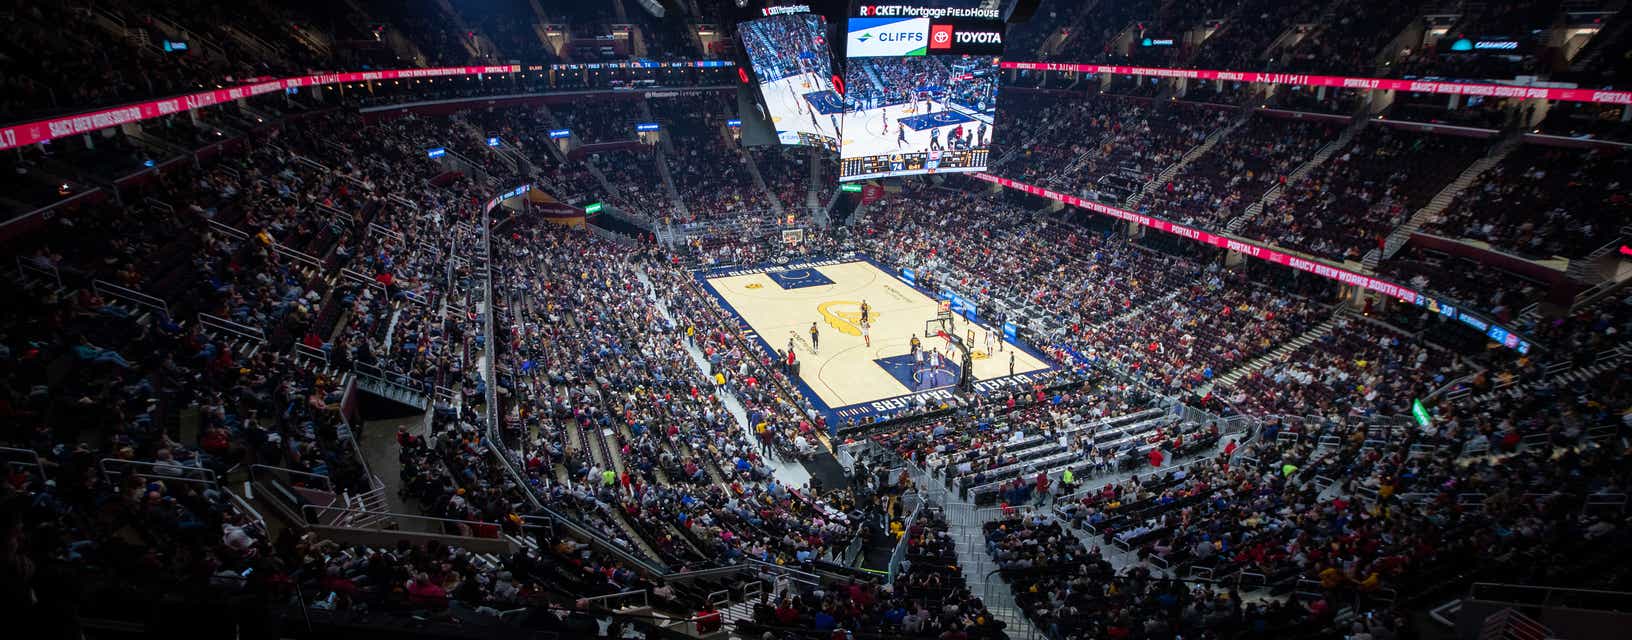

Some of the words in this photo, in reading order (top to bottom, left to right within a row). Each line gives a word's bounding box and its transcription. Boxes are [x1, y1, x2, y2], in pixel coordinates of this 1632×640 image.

[860, 5, 902, 16] ROCKET
[902, 6, 946, 19] Mortgage
[879, 32, 923, 42] CLIFFS
[955, 32, 1001, 44] TOYOTA
[1343, 79, 1369, 88] PORTAL
[1370, 80, 1380, 88] 17
[1409, 82, 1437, 93] SAUCY
[1437, 83, 1462, 94] BREW
[1462, 85, 1494, 96] WORKS
[1494, 86, 1526, 97] SOUTH
[1526, 88, 1548, 98] PUB
[1592, 91, 1632, 103] PORTAL
[892, 163, 903, 171] 74
[1080, 199, 1094, 209] SAUCY
[1139, 216, 1150, 225] PUB
[1171, 225, 1193, 238] PORTAL
[1192, 231, 1200, 239] 17
[1227, 240, 1252, 254] PORTAL
[1252, 247, 1260, 256] 17
[728, 266, 785, 277] CLEVELAND
[1289, 257, 1315, 272] SAUCY
[1315, 264, 1338, 278] BREW
[1338, 270, 1368, 287] WORKS
[1368, 279, 1397, 296] SOUTH
[1398, 288, 1415, 303] PUB
[1441, 304, 1453, 317] 30
